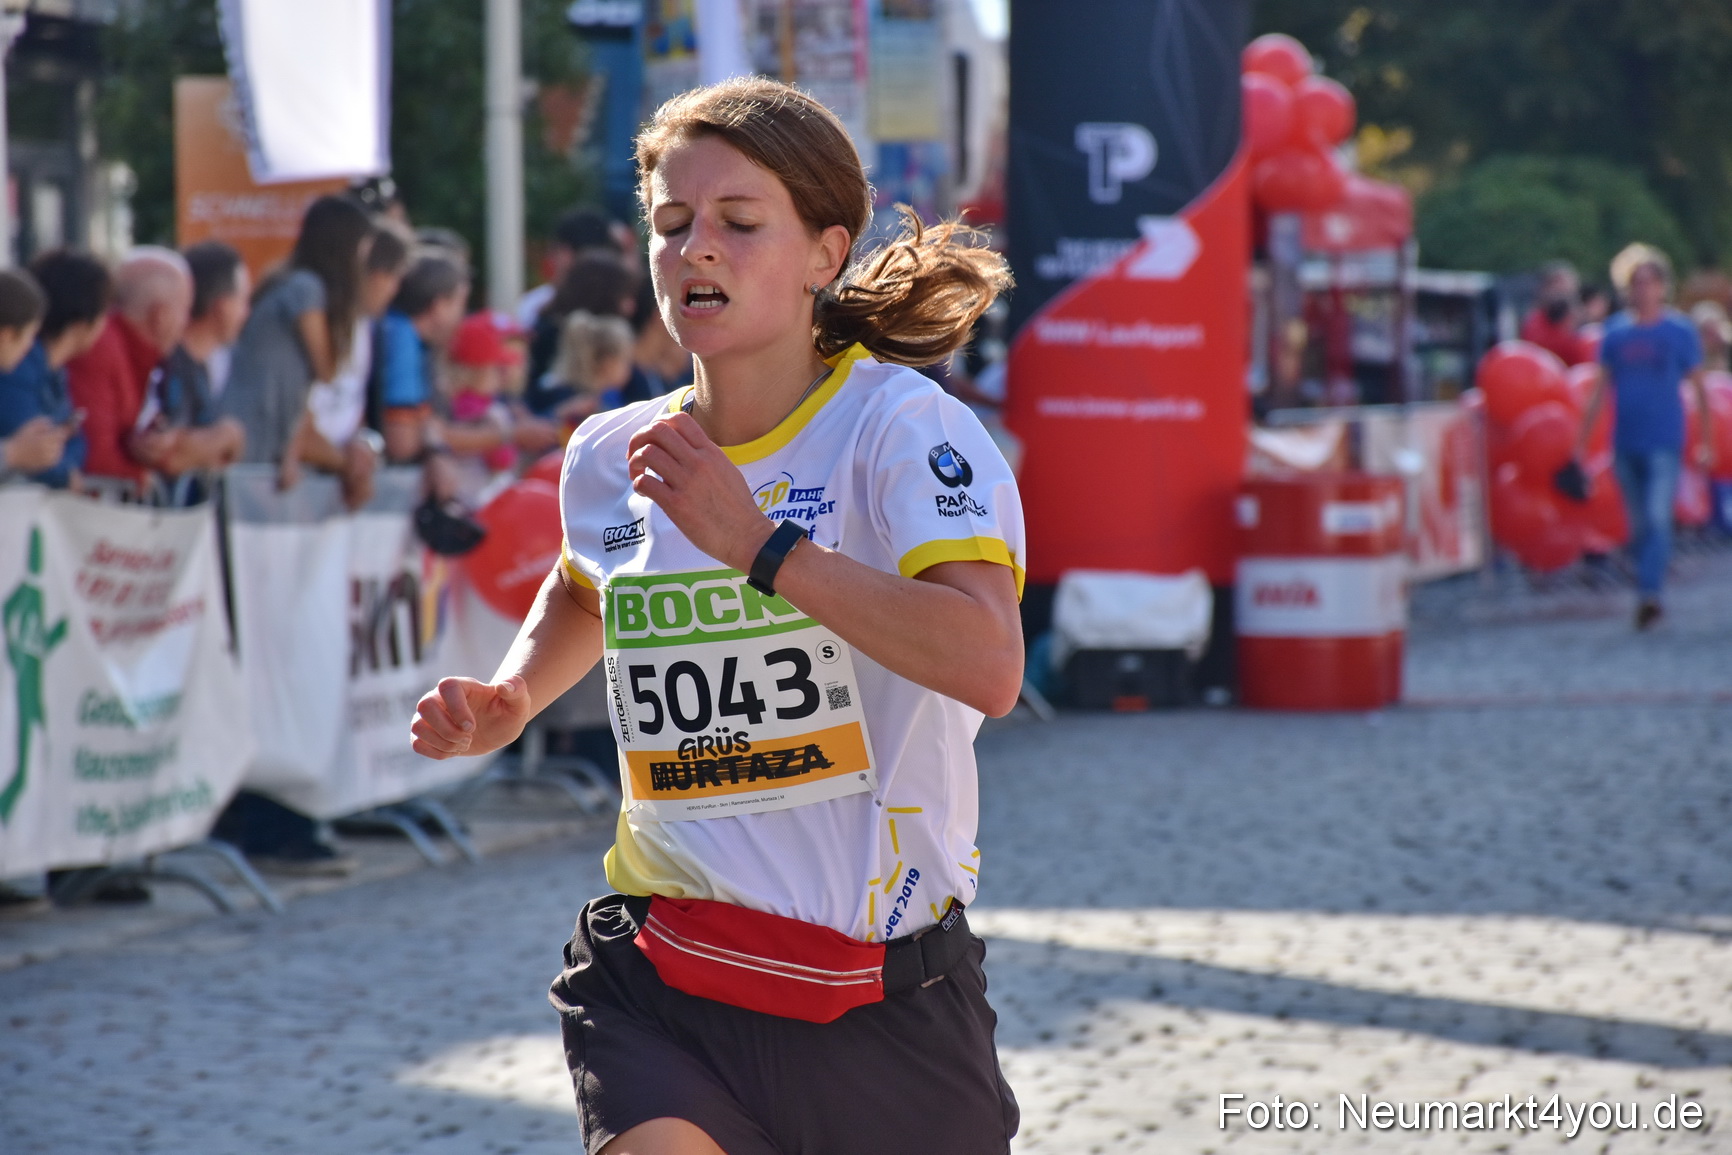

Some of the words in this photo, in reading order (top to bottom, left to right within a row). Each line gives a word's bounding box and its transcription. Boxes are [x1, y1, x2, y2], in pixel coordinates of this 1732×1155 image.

[758, 481, 790, 512] 20
[791, 488, 824, 502] JAHR
[603, 517, 645, 546] BOCK
[615, 578, 806, 638] BOCK
[628, 647, 821, 736] 5043
[896, 868, 920, 909] 2019
